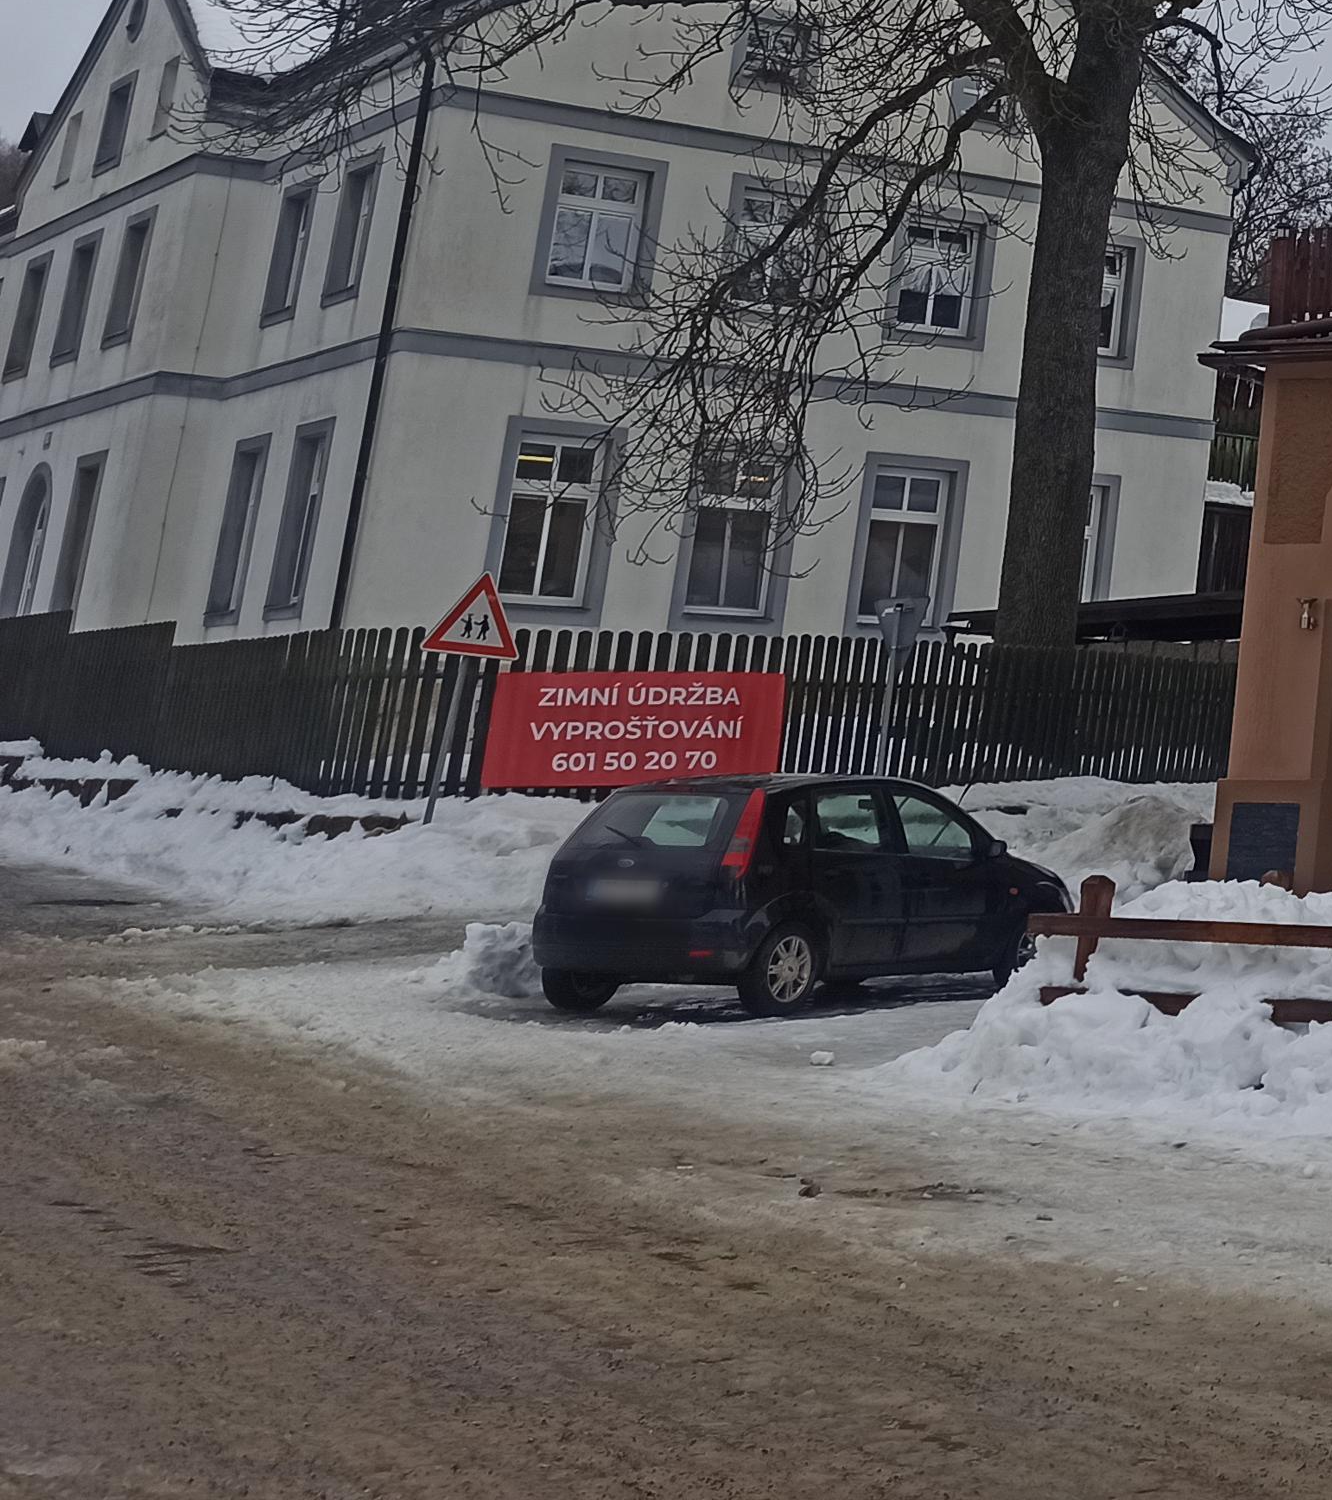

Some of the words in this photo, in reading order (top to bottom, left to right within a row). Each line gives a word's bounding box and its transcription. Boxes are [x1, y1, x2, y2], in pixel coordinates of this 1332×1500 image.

[538, 682, 620, 707] ZIMNÍ
[627, 682, 740, 706] ÚDRŽBA
[530, 715, 743, 741] VYPROŠŤOVÁNÍ
[551, 752, 595, 772] 601
[604, 751, 637, 771] 50
[644, 751, 677, 770] 20
[685, 750, 717, 770] 70
